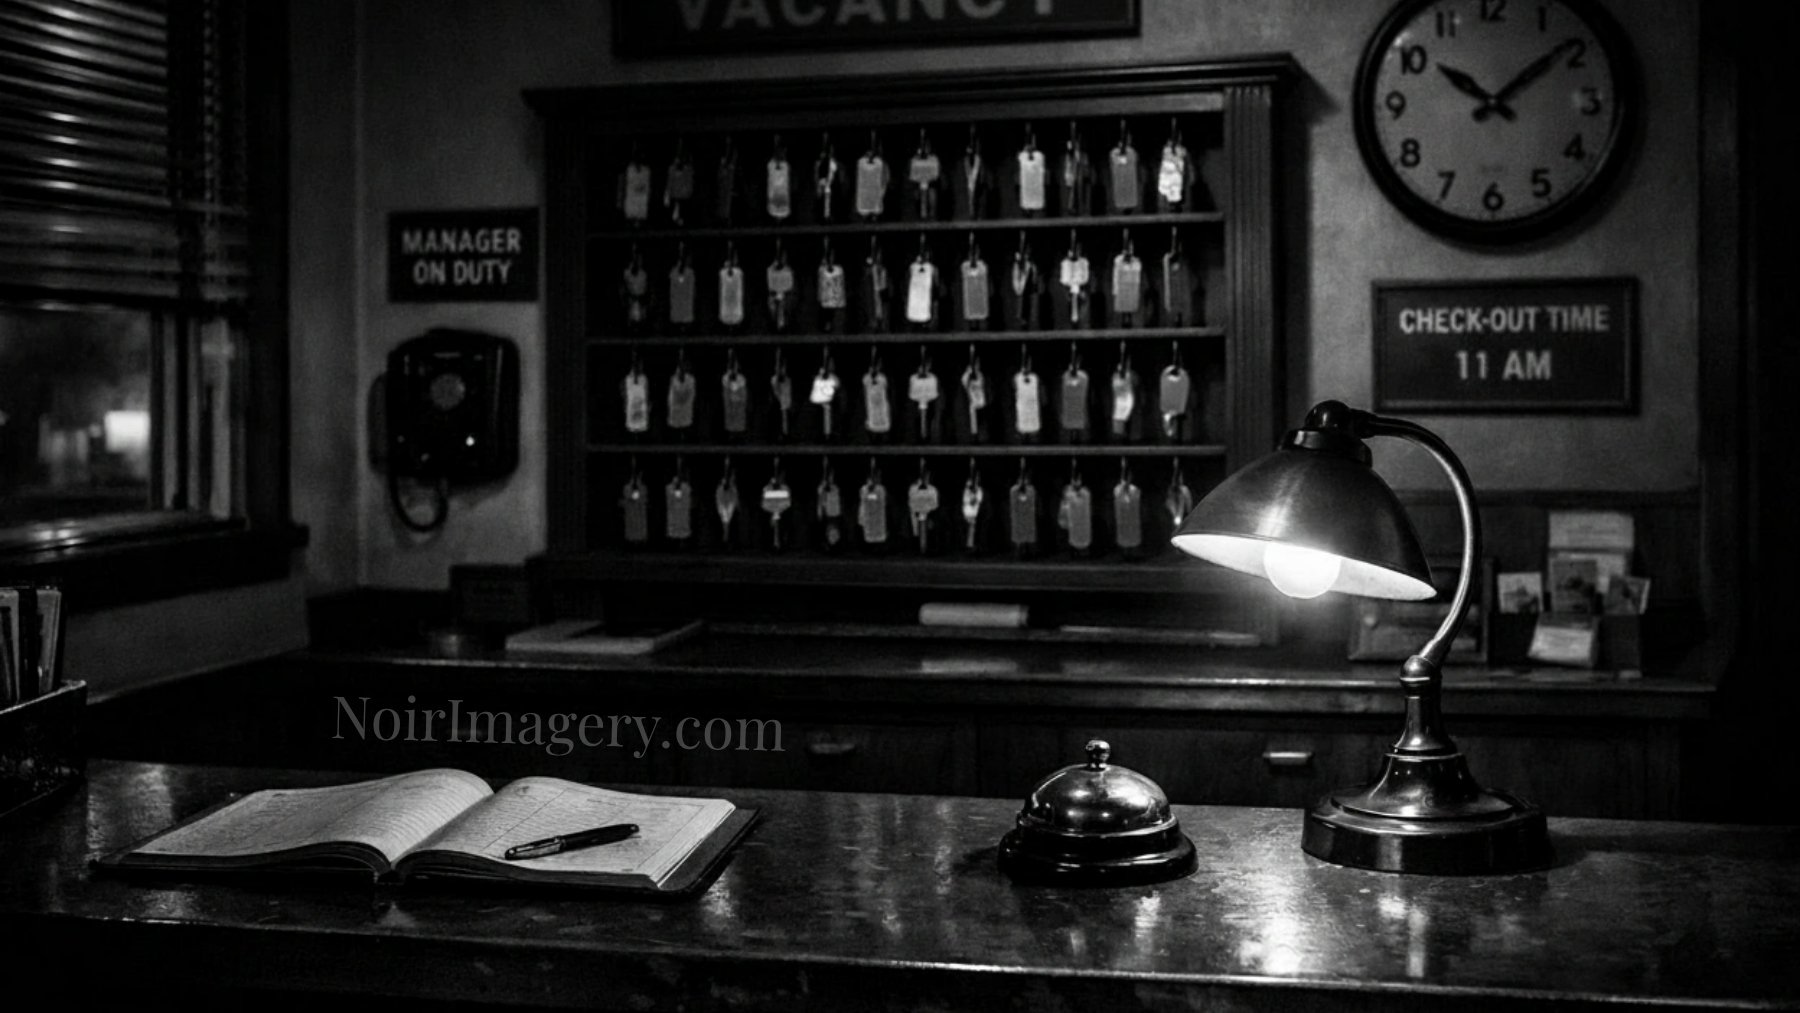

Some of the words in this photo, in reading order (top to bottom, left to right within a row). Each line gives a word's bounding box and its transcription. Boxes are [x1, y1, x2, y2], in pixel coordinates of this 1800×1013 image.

[1436, 11, 1455, 37] 11
[1480, 0, 1504, 21] 12
[1538, 7, 1546, 31] 1
[1402, 46, 1426, 74] 10
[1567, 39, 1586, 68] 2
[1386, 91, 1405, 119] 9
[1581, 87, 1601, 115] 3
[1401, 139, 1420, 167] 8
[1564, 134, 1584, 160] 4
[1438, 171, 1455, 199] 7
[1484, 182, 1503, 211] 6
[1531, 169, 1550, 197] 5
[401, 227, 521, 253] MANAGER
[412, 260, 446, 286] ON
[453, 258, 512, 286] DUTY
[1399, 307, 1541, 334] CHECK-OUT
[1546, 305, 1610, 332] TIME
[1456, 350, 1488, 380] 11
[1502, 350, 1553, 380] AM
